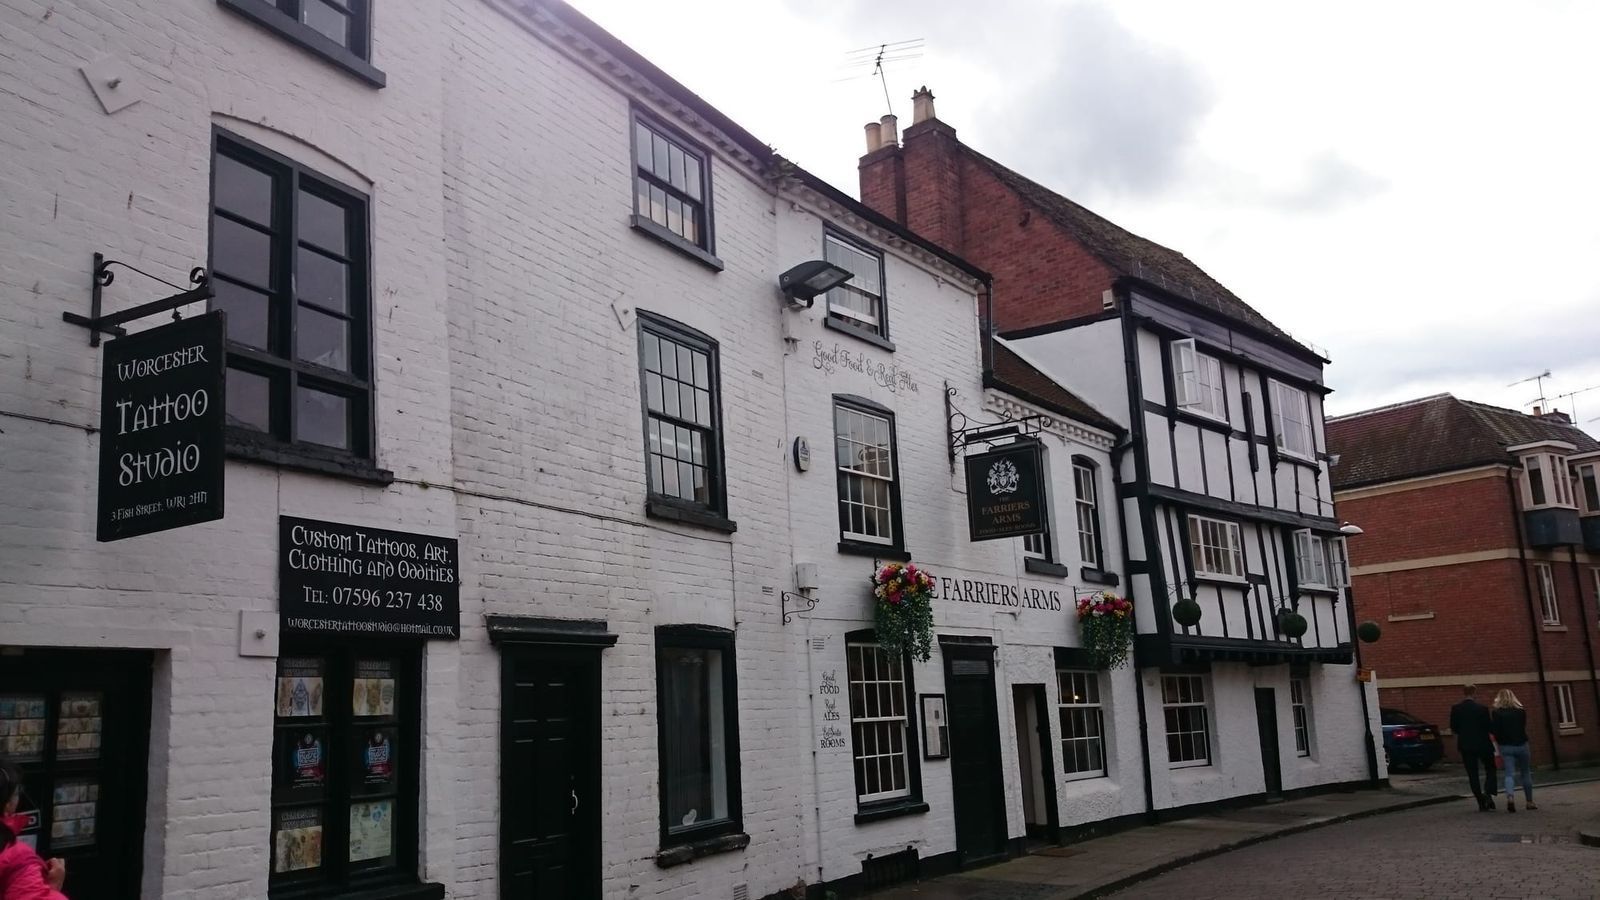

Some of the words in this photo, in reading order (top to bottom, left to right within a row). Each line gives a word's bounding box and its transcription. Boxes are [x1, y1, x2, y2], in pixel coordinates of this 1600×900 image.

[813, 340, 838, 376] Good
[840, 349, 863, 373] Food
[874, 363, 899, 393] Real
[982, 500, 1031, 515] FARRIERS
[992, 513, 1021, 525] ARMS
[332, 586, 381, 608] 07596
[385, 590, 412, 610] 237
[417, 593, 443, 612] 438
[941, 576, 1018, 608] FARRIERS
[1021, 586, 1062, 612] ARMS
[819, 685, 840, 695] FOOD
[823, 711, 840, 721] ALES
[820, 738, 846, 749] ROOMS
